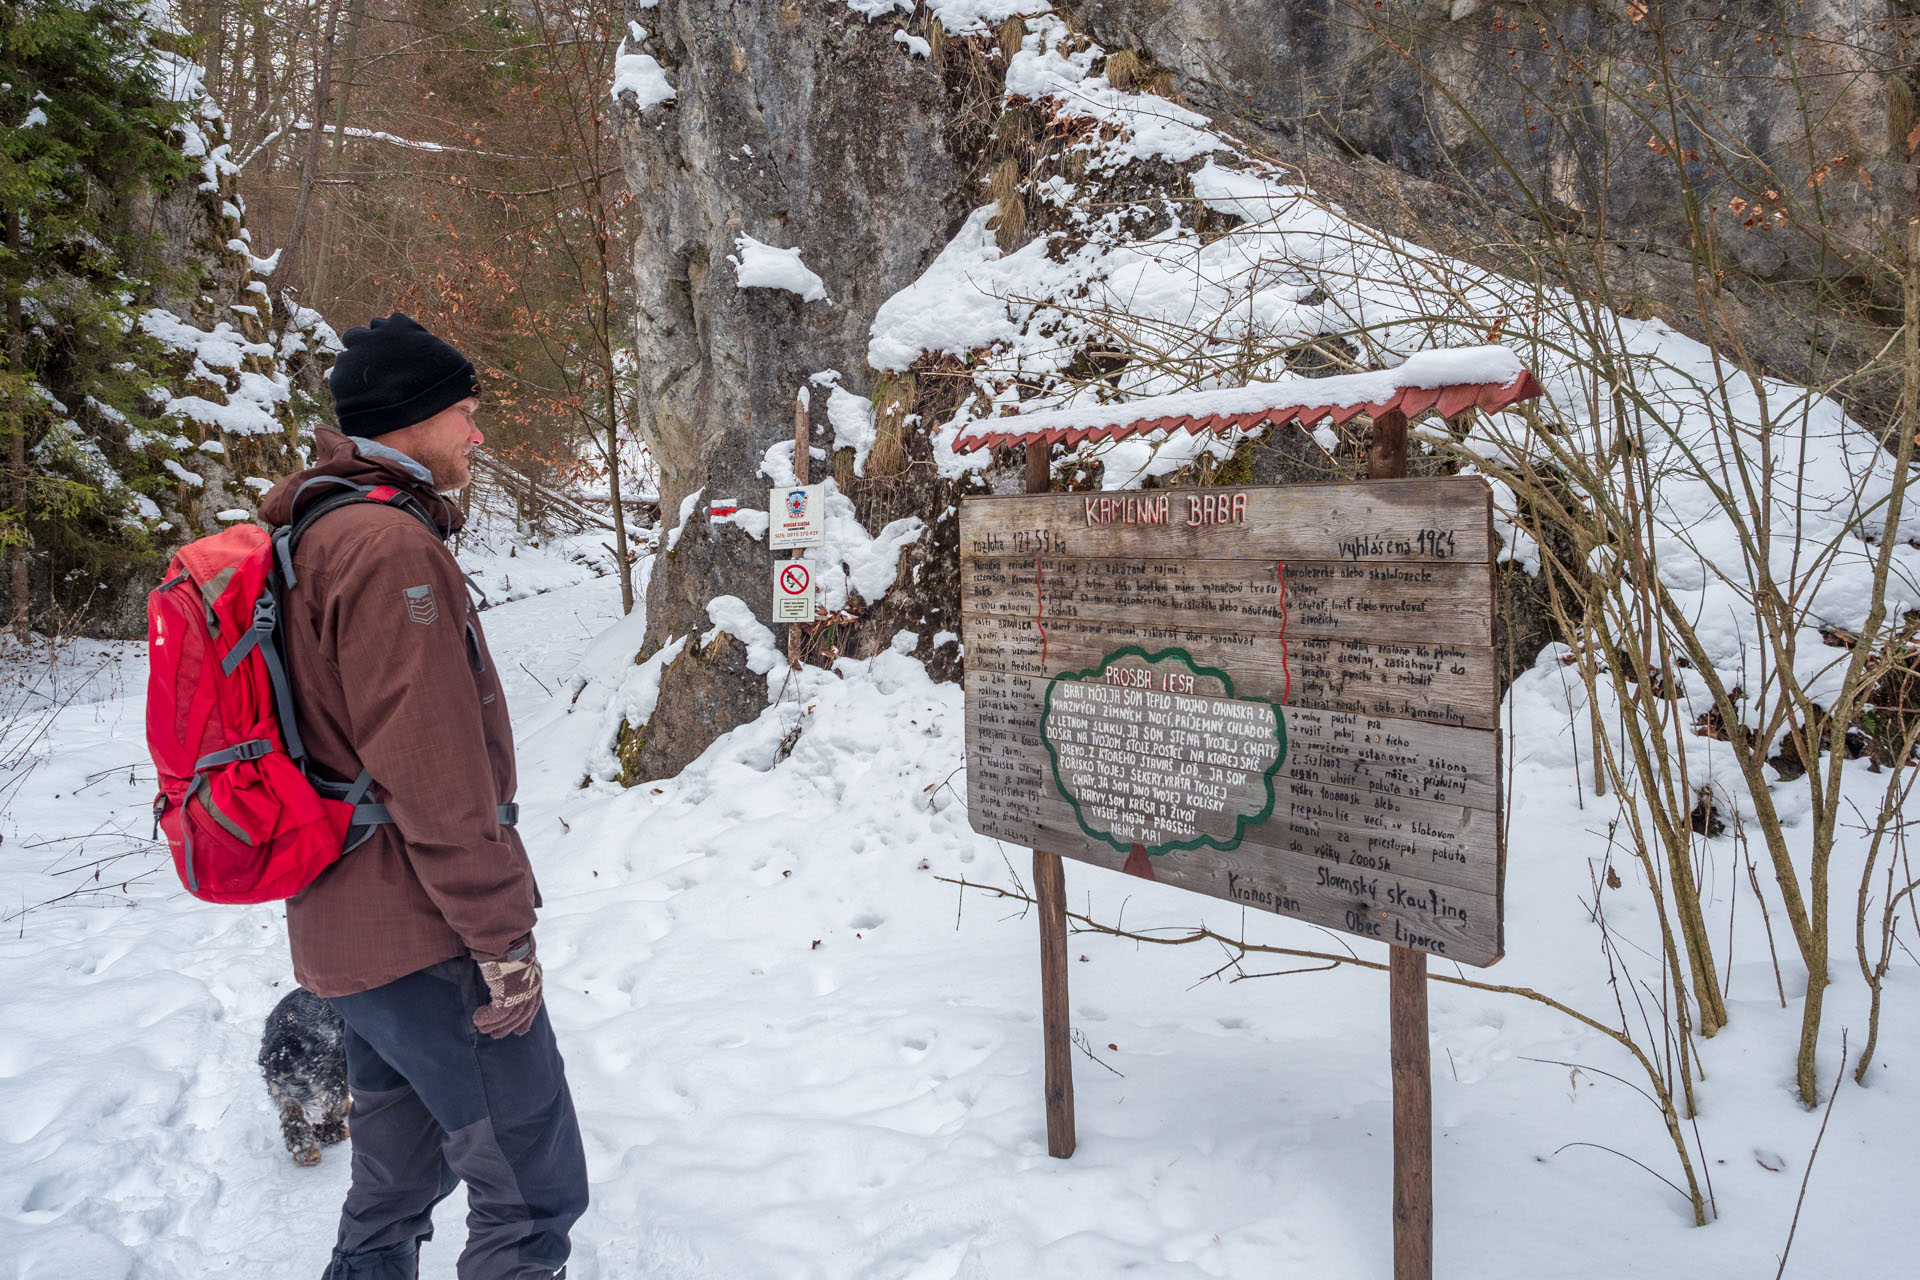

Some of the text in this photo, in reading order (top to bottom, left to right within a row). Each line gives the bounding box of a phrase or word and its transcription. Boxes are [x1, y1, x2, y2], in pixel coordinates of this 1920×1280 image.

[1084, 492, 1247, 527] KAMENNÁ BABA
[973, 533, 1004, 553] rozloha
[1055, 533, 1066, 554] ha
[1338, 529, 1455, 561] vyhlásená 1964
[1341, 565, 1364, 578] alebo
[1250, 581, 1277, 593] trasu
[1219, 599, 1238, 612] alebo
[1357, 598, 1377, 610] alebo
[1105, 666, 1195, 695] PROSBA LESA
[1382, 673, 1387, 682] a
[1450, 662, 1466, 675] do
[1064, 684, 1085, 699] BRAT
[1124, 689, 1143, 706] SOM
[1146, 692, 1171, 710] TEPLO
[1175, 696, 1208, 714] TVOJHO
[1212, 702, 1254, 719] OHNISKA
[1259, 708, 1274, 724] ZA
[1374, 700, 1395, 713] alebo
[1051, 698, 1096, 715] MRAZIVÝCH
[1227, 722, 1273, 739] CHLÁDOK
[1047, 726, 1072, 742] DOSKA
[1077, 732, 1088, 744] NA
[1091, 732, 1121, 750] TVOJOM
[1190, 749, 1204, 763] NA
[1208, 752, 1238, 768] KTOREJ
[1049, 715, 1055, 725] V
[1058, 716, 1088, 731] LETNOM
[1143, 726, 1164, 742] SOM
[1170, 730, 1200, 748] STENA
[1203, 734, 1237, 754] TVOJEJ
[1334, 728, 1354, 742] pokoj
[1365, 735, 1371, 743] a
[1385, 734, 1410, 747] ticho
[1060, 756, 1094, 773] PORISKO
[1096, 760, 1125, 778] TVOJEJ
[1194, 780, 1227, 799] TVOJEJ
[1099, 748, 1136, 766] KTORÉHO
[1140, 755, 1174, 772] STAVIAŠ
[1209, 767, 1222, 782] JA
[1226, 770, 1246, 785] SOM
[1429, 757, 1467, 773] zákona
[1075, 789, 1079, 799] I
[1160, 804, 1167, 816] A
[1112, 779, 1130, 794] SOM
[1133, 783, 1150, 797] DNO
[1152, 788, 1181, 804] TVOJEJ
[1187, 793, 1225, 812] KOLÍSKY
[1375, 796, 1401, 812] alebo
[1409, 787, 1420, 797] až
[1434, 790, 1445, 801] do
[1291, 802, 1349, 821] prepadnutie
[1412, 821, 1455, 840] blokovom
[1141, 828, 1161, 847] MA!
[1290, 840, 1303, 851] do
[1337, 832, 1350, 842] za
[1369, 838, 1416, 857] priestupok
[1433, 847, 1466, 863] pokuta
[1228, 871, 1300, 912] Kronospan
[1316, 866, 1378, 900] Slovenský
[1345, 911, 1381, 937] Obec
